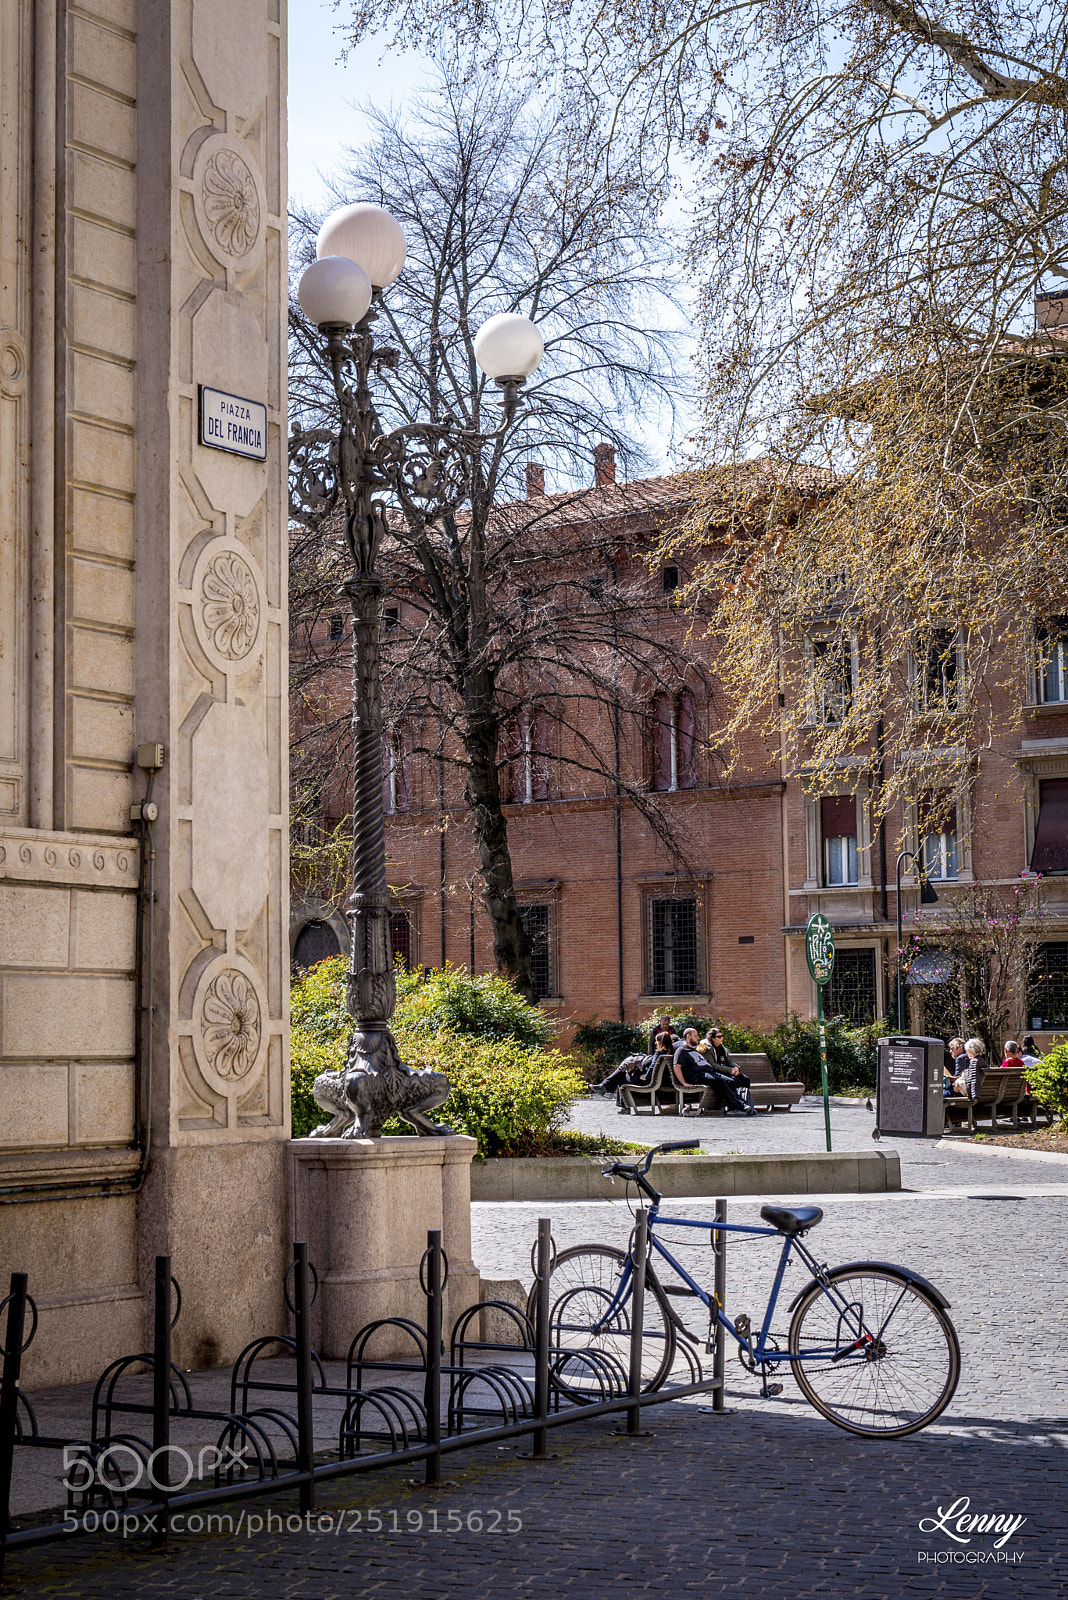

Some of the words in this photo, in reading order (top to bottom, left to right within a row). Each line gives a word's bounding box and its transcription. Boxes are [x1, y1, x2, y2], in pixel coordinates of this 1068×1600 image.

[220, 401, 251, 421] PIAZZA
[208, 416, 224, 438] DEL
[227, 422, 262, 449] FRANCIA
